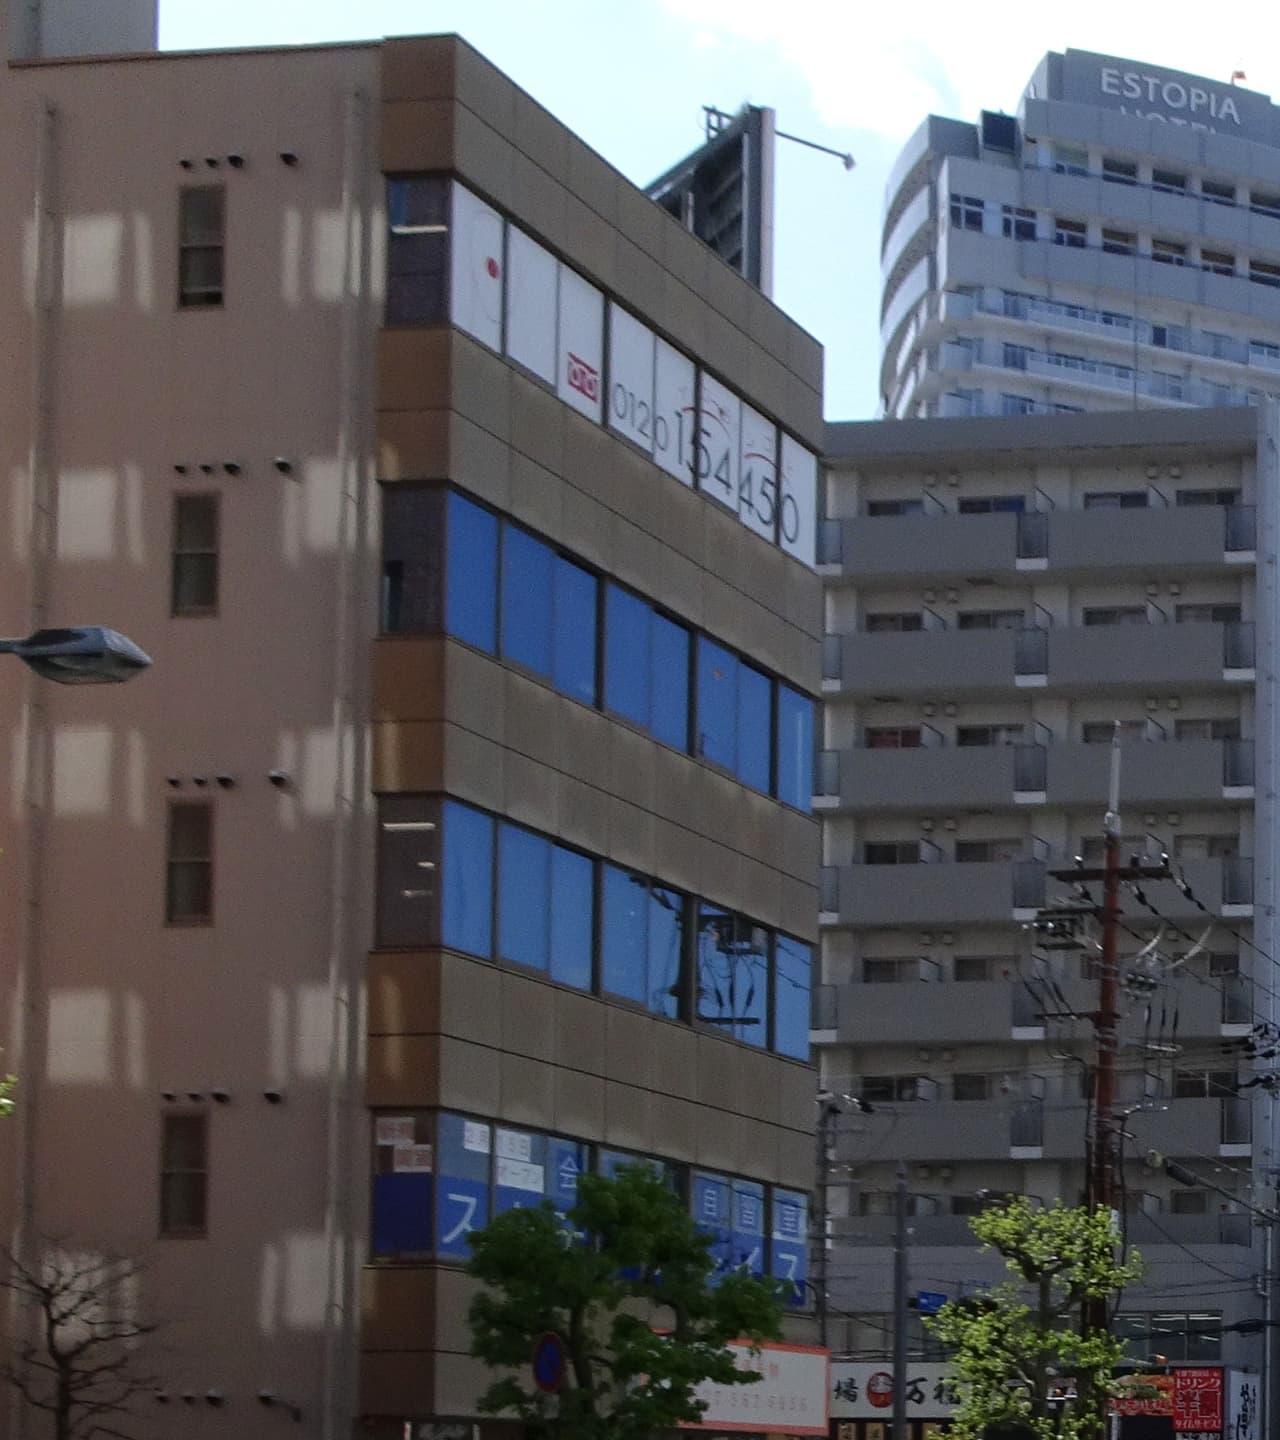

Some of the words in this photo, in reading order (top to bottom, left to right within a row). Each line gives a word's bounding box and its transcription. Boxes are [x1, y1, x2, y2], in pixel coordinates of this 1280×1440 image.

[1101, 67, 1240, 126] ESTOPIA
[1176, 1378, 1221, 1389] ドリンク
